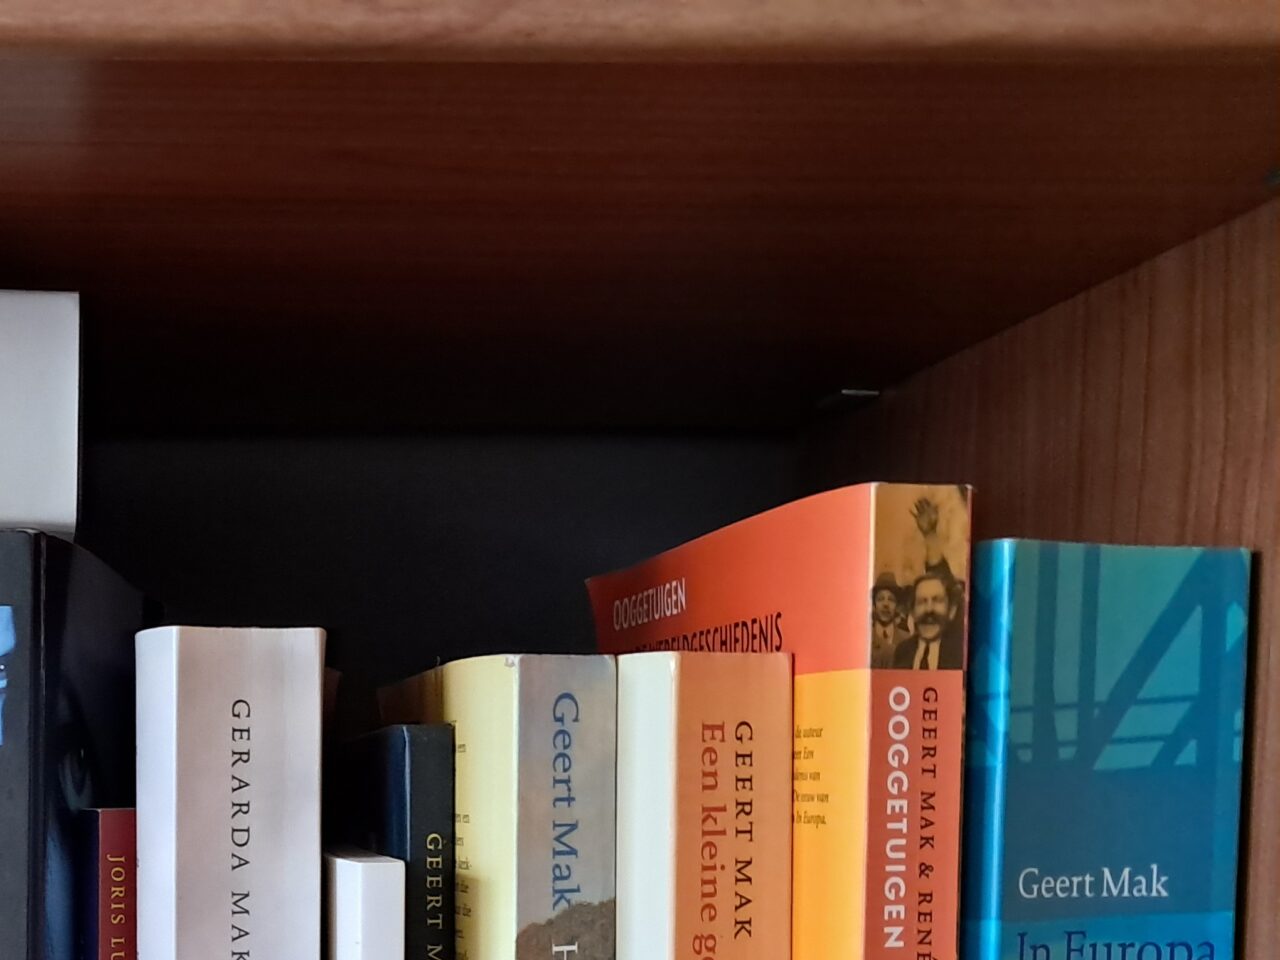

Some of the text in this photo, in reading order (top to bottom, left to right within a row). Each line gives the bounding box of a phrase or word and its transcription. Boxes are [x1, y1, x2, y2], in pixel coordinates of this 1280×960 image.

[612, 577, 687, 631] OOGGETUIGEN
[552, 691, 580, 809] Geert
[701, 720, 726, 792] Een
[920, 686, 939, 778] GEERT
[230, 698, 252, 872] GERARDA
[732, 720, 754, 939] GEERT MAK
[883, 685, 911, 948] OOGGETUIGEN
[919, 791, 937, 850] MAK
[107, 855, 126, 925] JORIS
[425, 832, 443, 931] GEERT
[551, 819, 581, 911] Mak
[700, 804, 727, 924] kleine
[918, 861, 934, 880] &
[1018, 863, 1169, 899] Geert Mak
